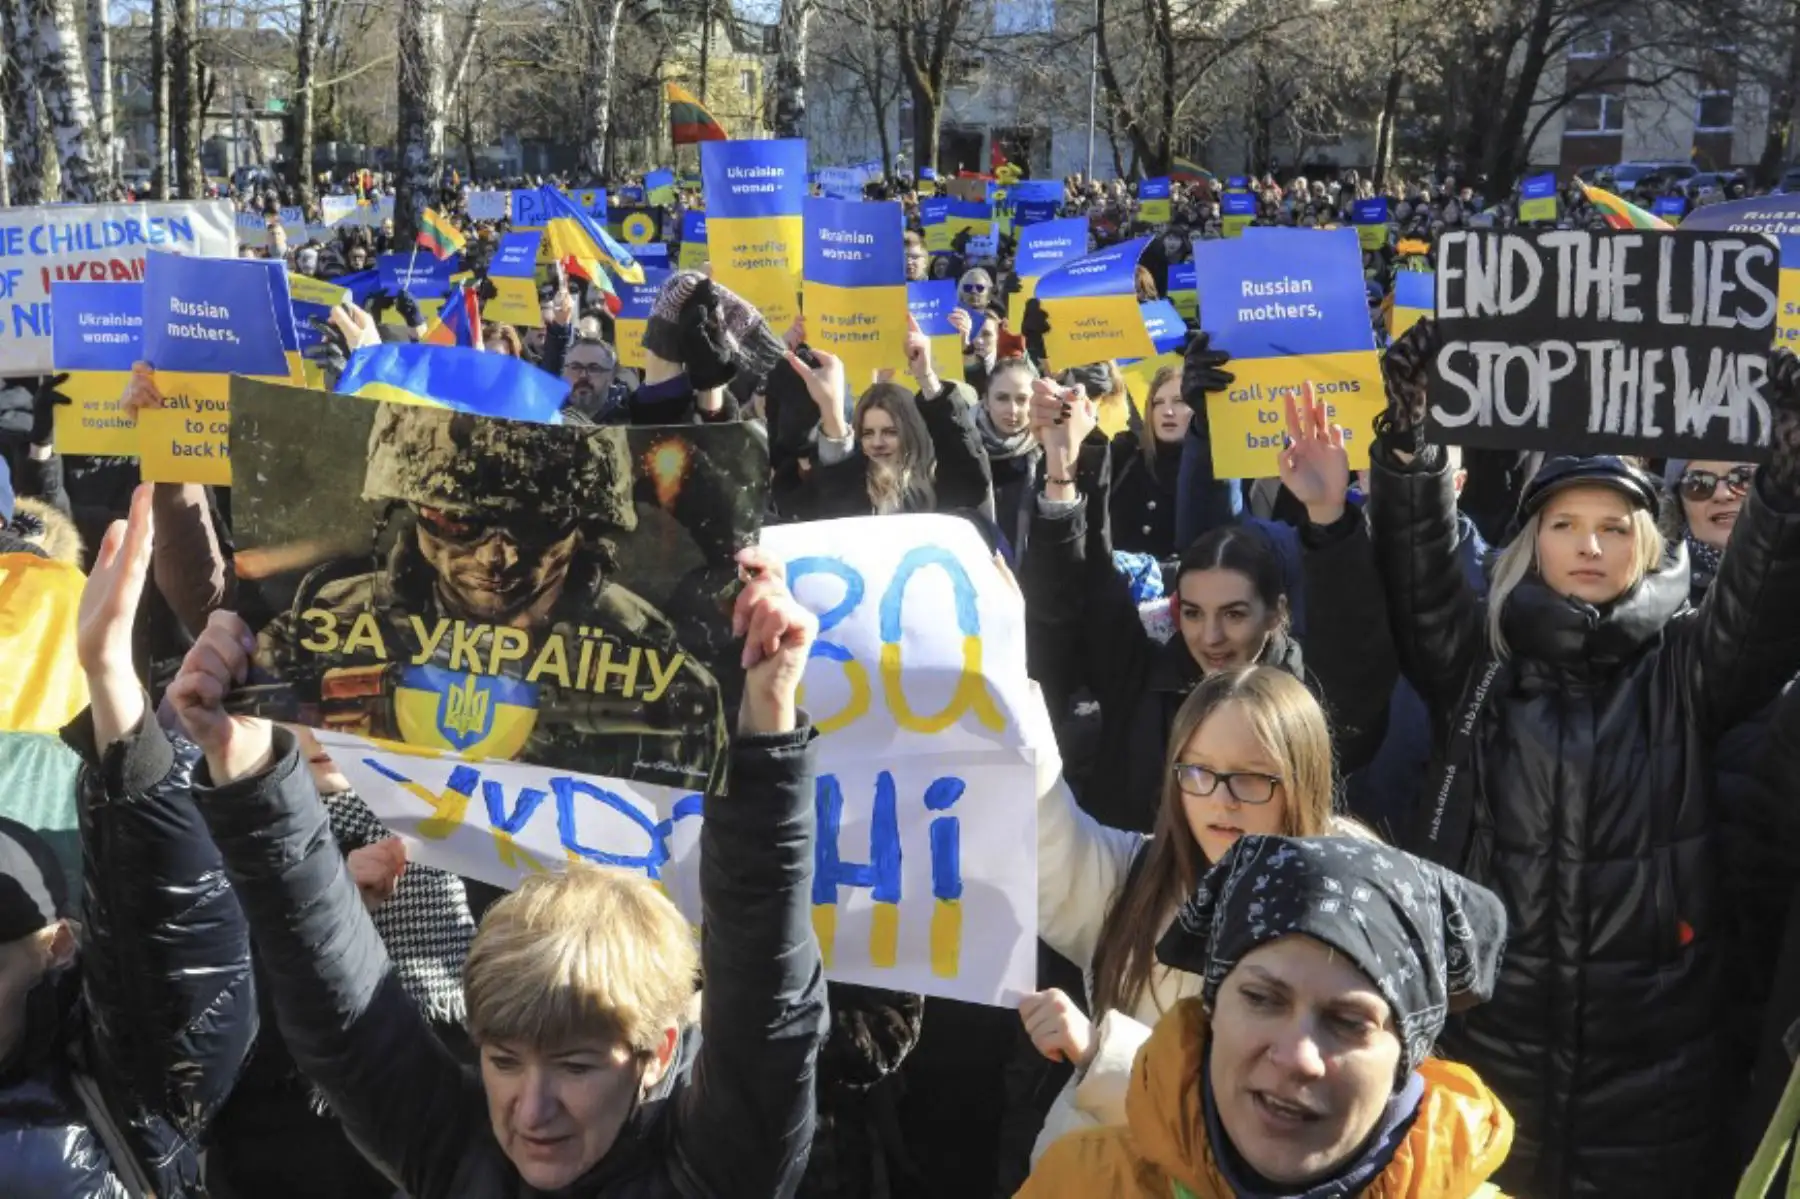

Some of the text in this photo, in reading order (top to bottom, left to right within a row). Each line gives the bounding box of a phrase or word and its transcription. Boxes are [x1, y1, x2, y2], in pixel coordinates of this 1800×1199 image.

[29, 216, 195, 256] CHILDREN
[1242, 276, 1312, 298] Russian
[1437, 230, 1778, 329] END THE LIES
[169, 295, 229, 319] Russian
[1238, 299, 1323, 322] mothers,
[78, 312, 143, 327] Ukrainian
[83, 332, 130, 344] woman
[167, 322, 240, 345] mothers,
[161, 392, 191, 409] call
[1229, 380, 1360, 402] call you sons
[1431, 340, 1772, 447] STOP THE WAR
[185, 417, 230, 434] to co
[1258, 408, 1279, 423] to
[172, 438, 215, 458] back
[300, 609, 687, 701] ЗА УКРАЇНУ
